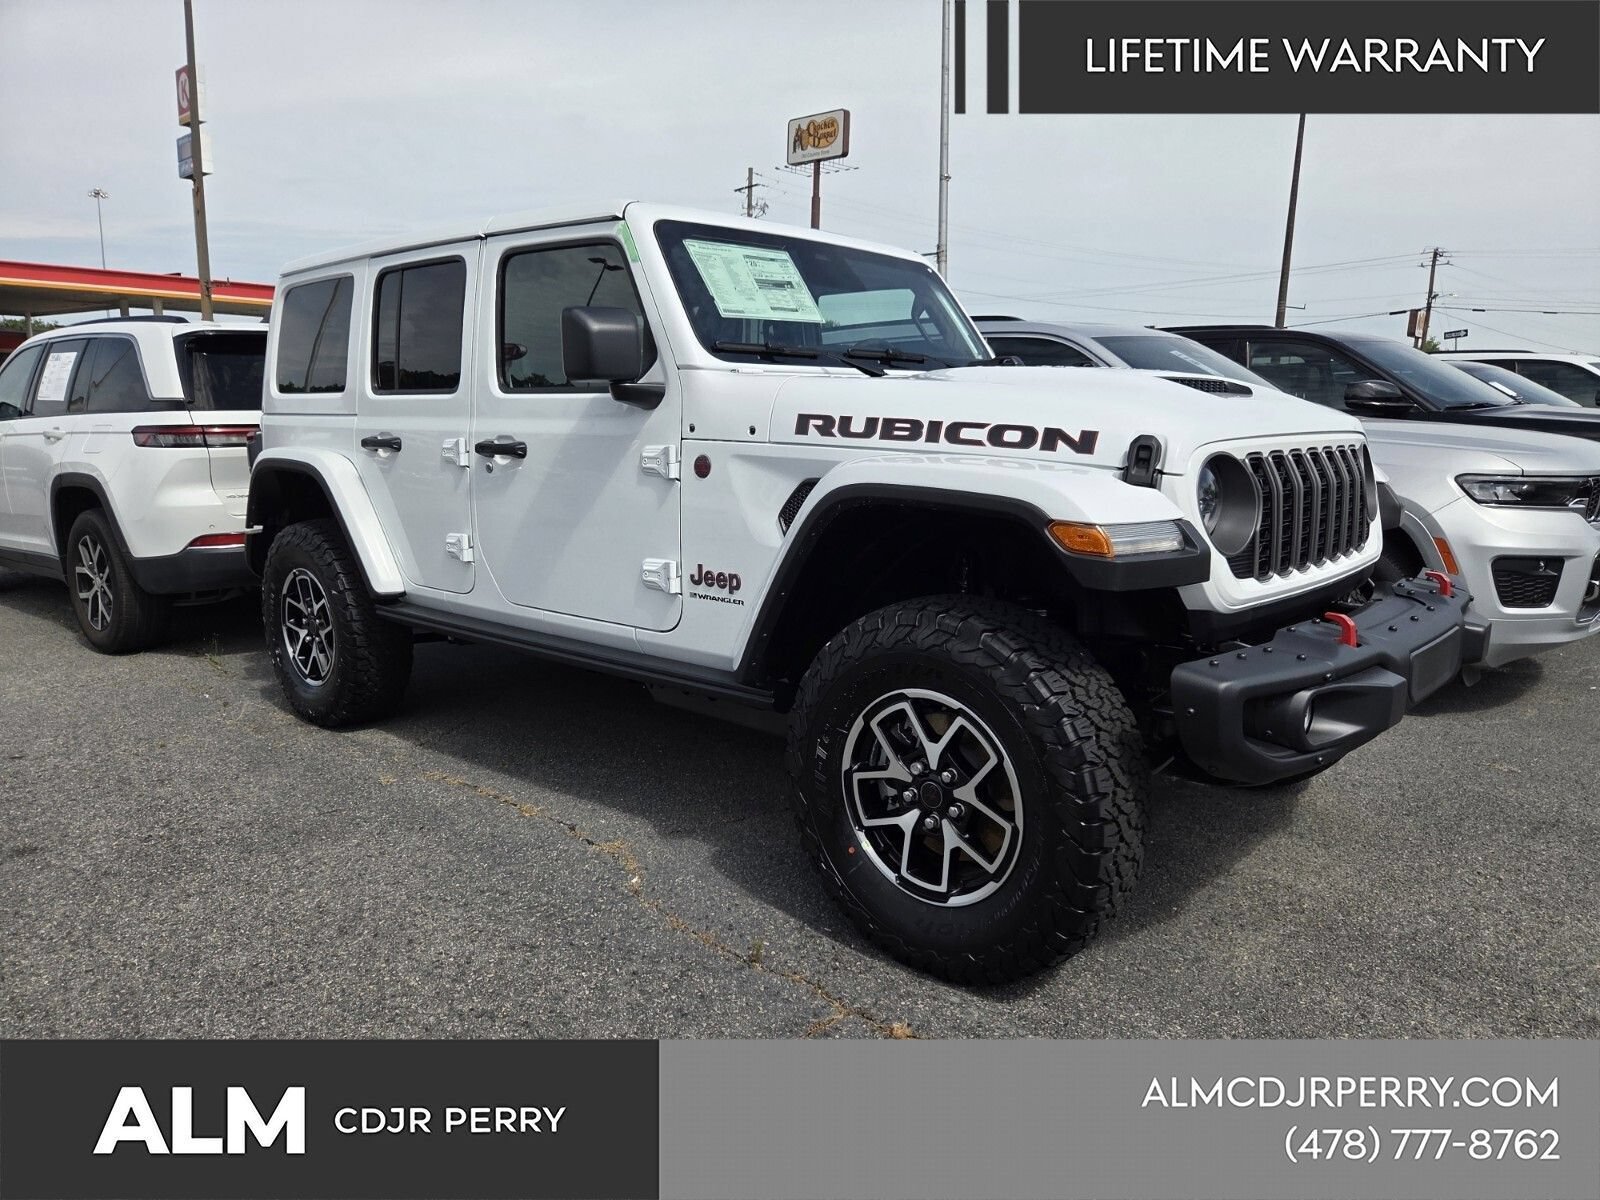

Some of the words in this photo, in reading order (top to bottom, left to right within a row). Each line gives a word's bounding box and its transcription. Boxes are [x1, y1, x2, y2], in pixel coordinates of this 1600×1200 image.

[794, 413, 1099, 455] RUBICON
[689, 563, 742, 595] Jeep
[697, 592, 745, 606] WRANGLER
